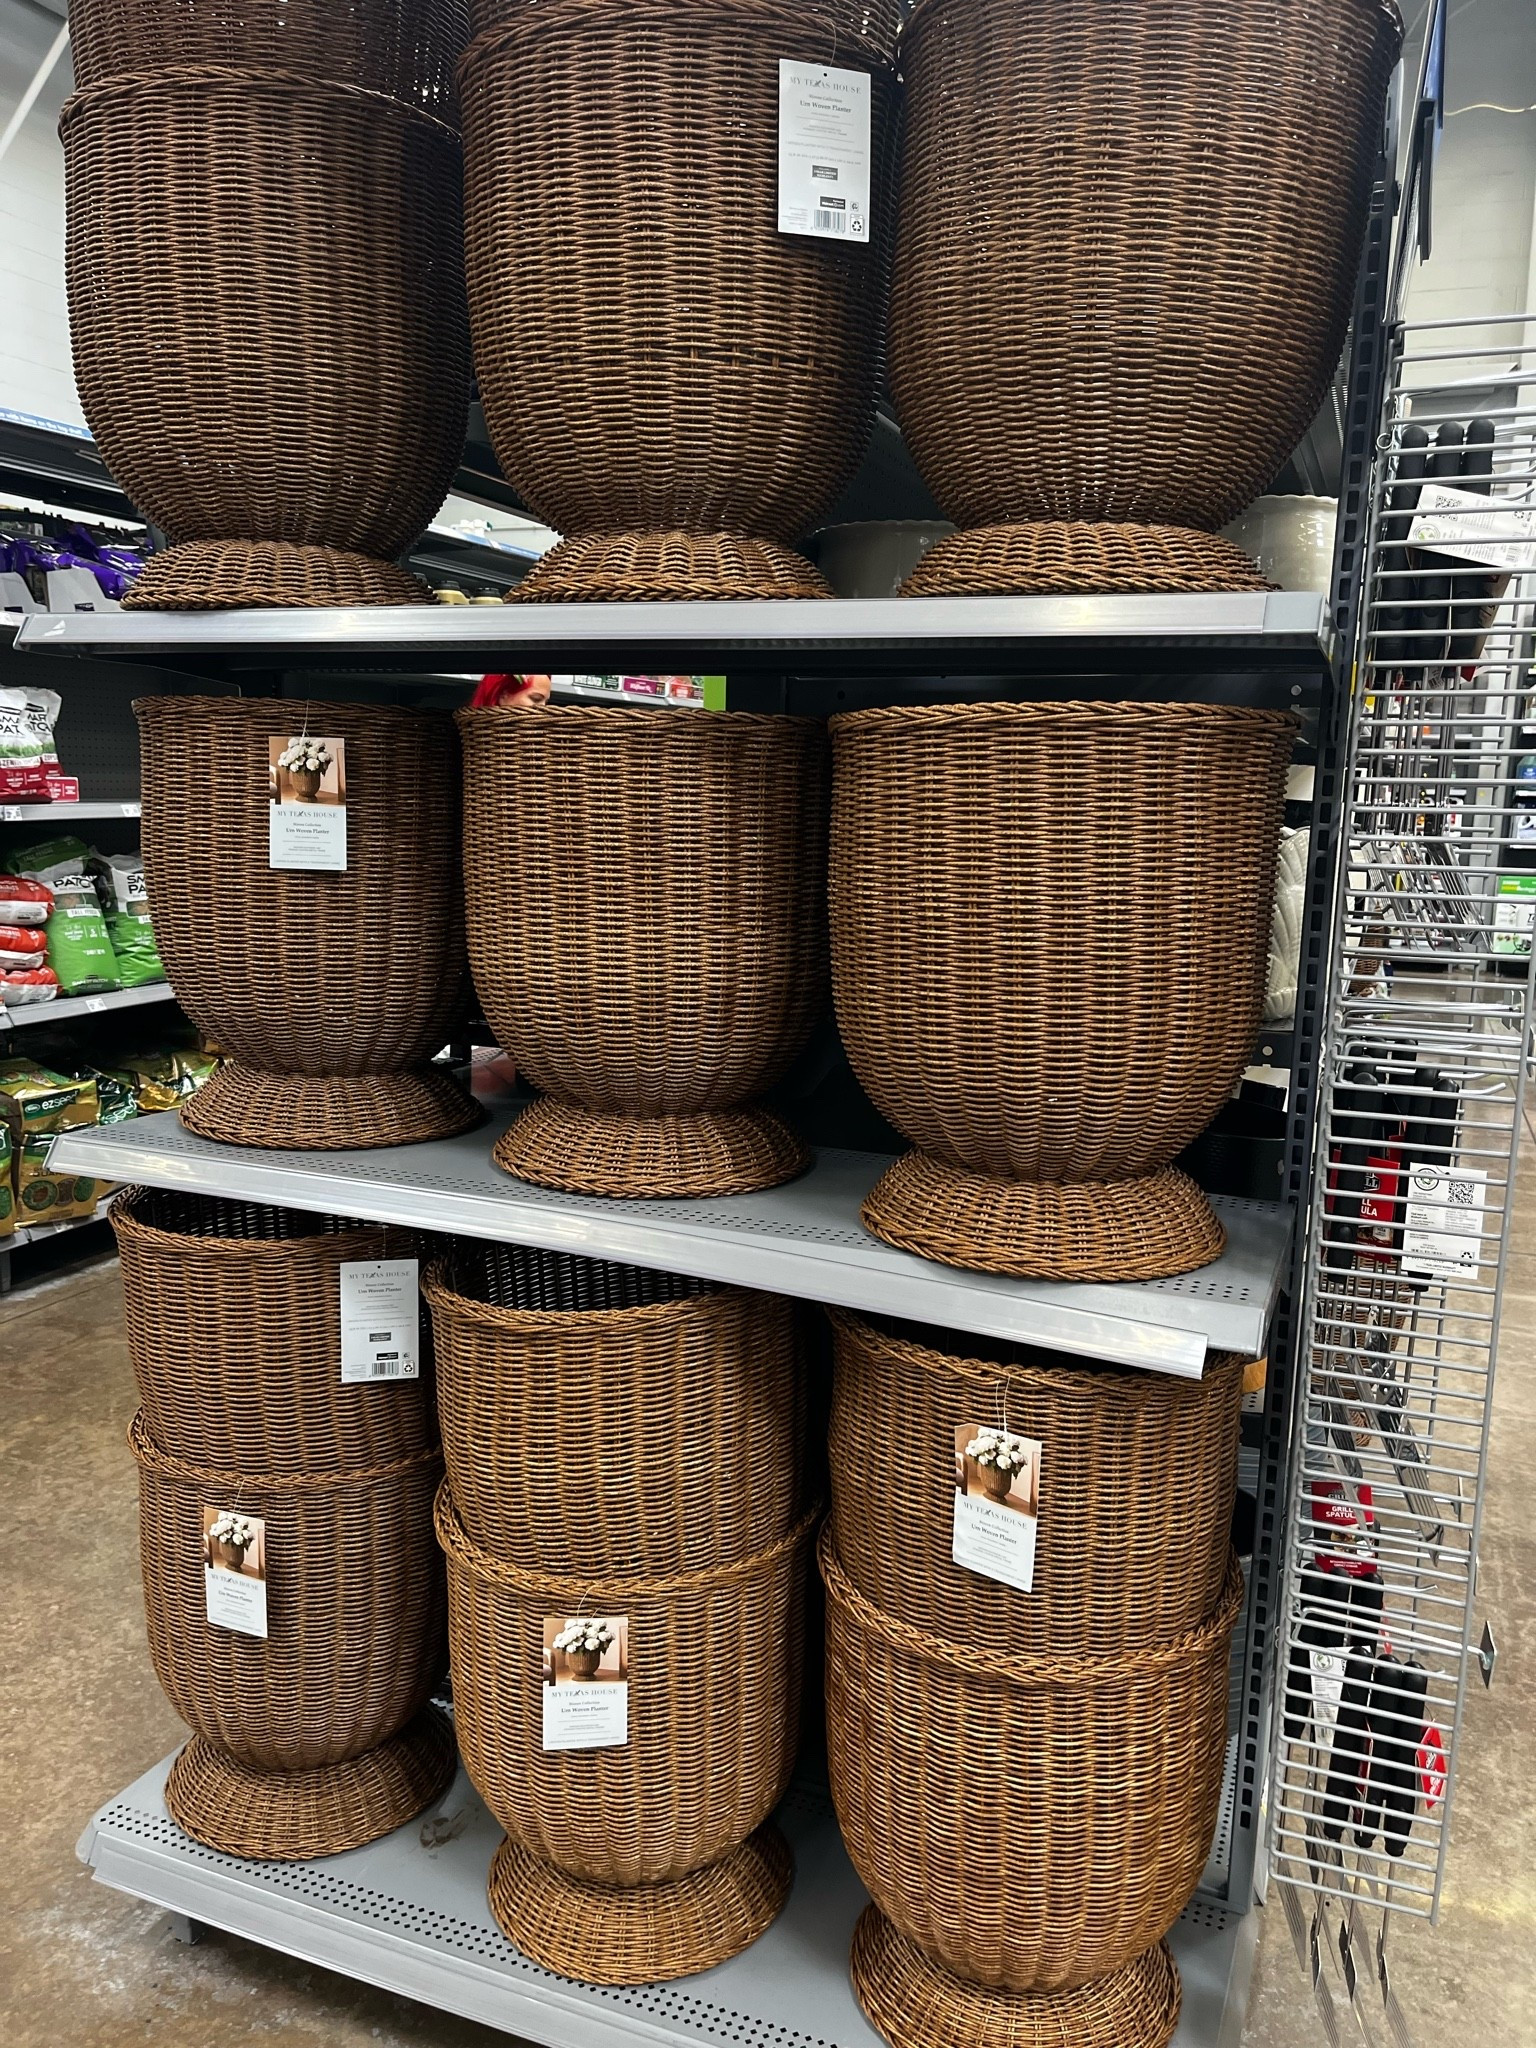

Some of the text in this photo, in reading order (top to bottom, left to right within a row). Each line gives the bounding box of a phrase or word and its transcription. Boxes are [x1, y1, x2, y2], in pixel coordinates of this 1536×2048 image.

[804, 79, 830, 88] TEXAS
[833, 83, 861, 94] HOUSE
[812, 102, 831, 110] Woven
[832, 105, 851, 113] Planter
[976, 1507, 999, 1518] TEXAS
[1001, 1515, 1028, 1530] HOUSE
[1326, 1511, 1356, 1519] SPATUL
[1000, 1533, 1017, 1544] Planter
